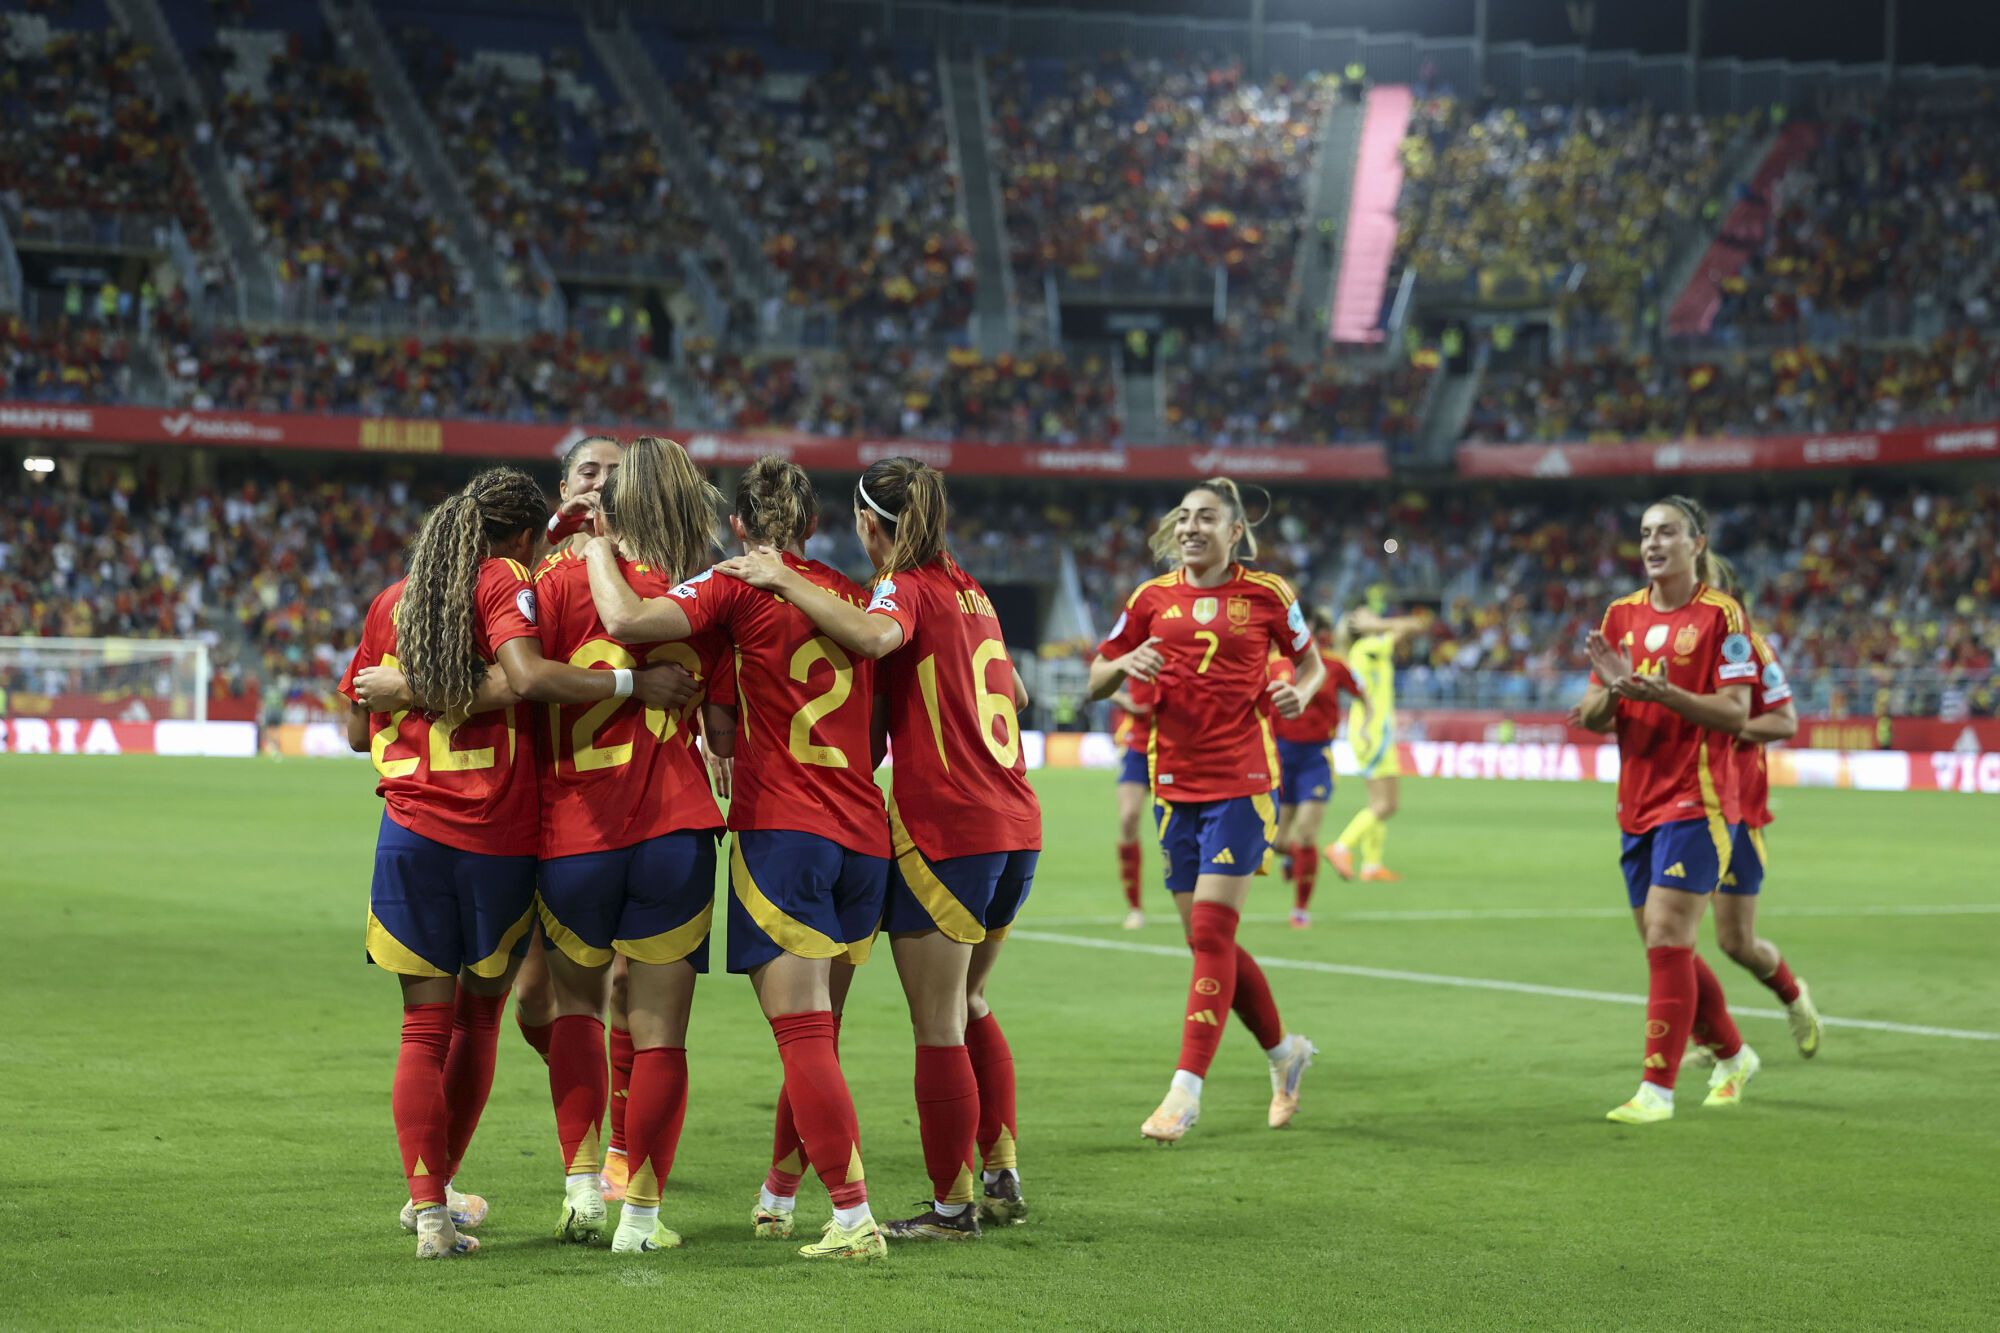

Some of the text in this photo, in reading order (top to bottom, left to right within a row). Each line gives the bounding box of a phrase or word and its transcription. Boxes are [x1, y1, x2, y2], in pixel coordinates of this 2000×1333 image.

[1194, 631, 1219, 674] 7
[789, 636, 853, 769] 2
[972, 638, 1019, 769] 6
[0, 717, 122, 755] RIA
[1411, 742, 1574, 781] VICTORIA
